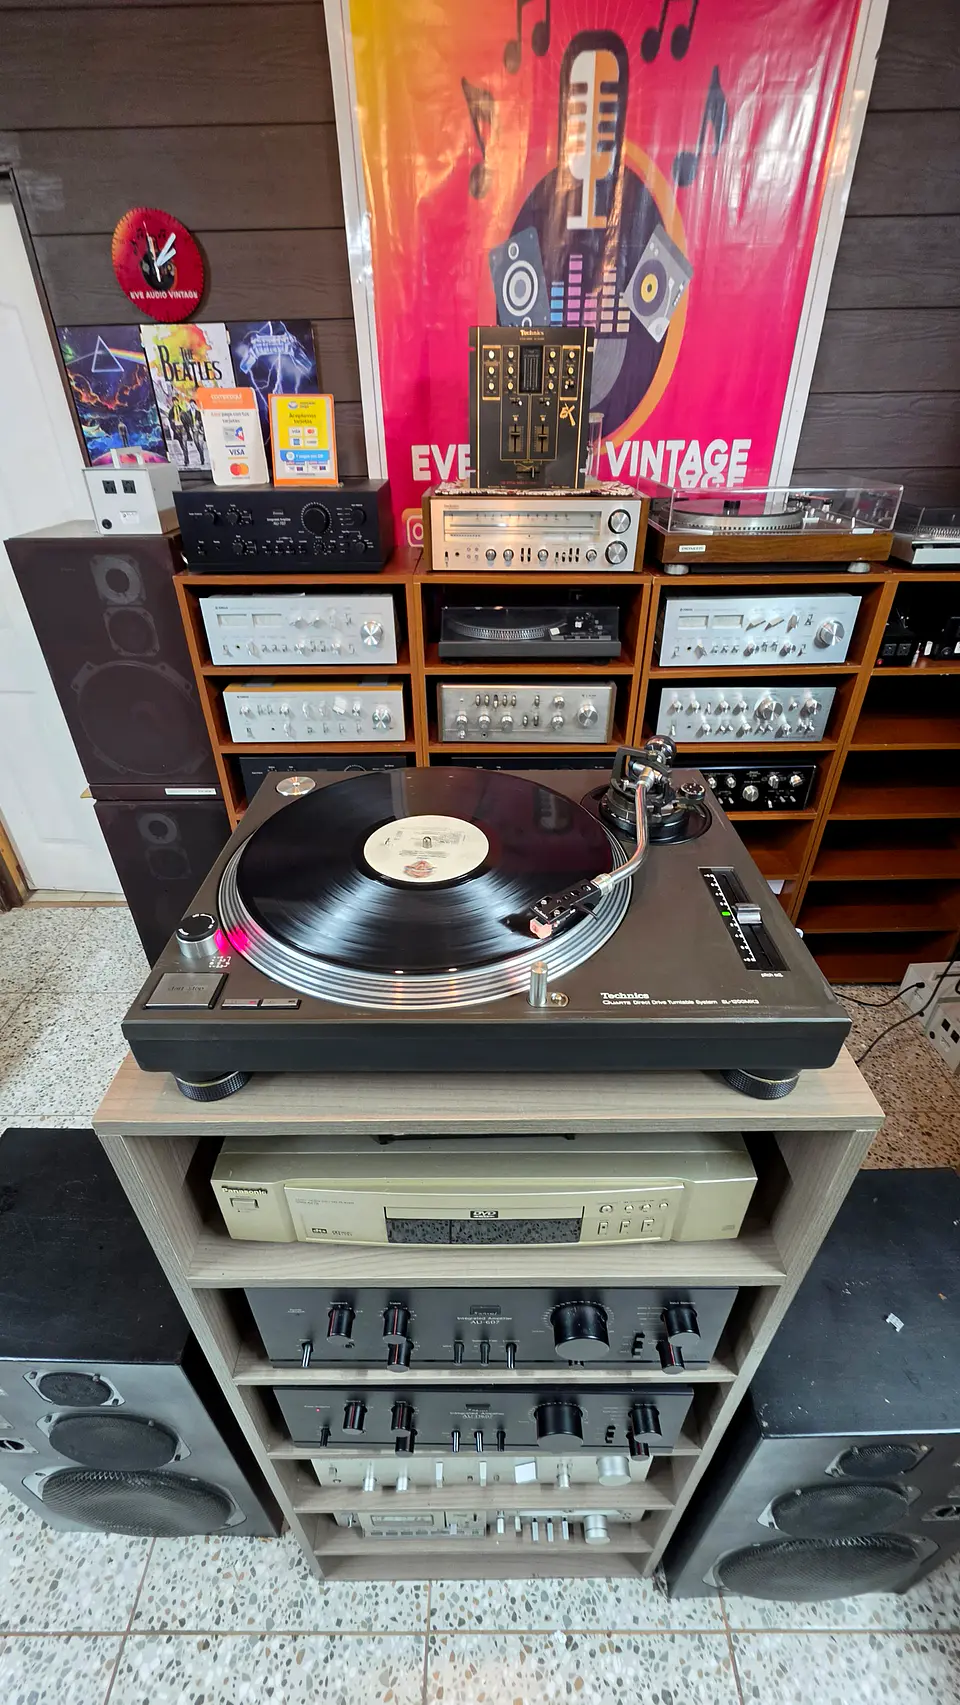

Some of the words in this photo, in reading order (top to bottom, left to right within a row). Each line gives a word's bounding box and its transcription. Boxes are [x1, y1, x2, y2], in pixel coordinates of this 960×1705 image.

[145, 290, 167, 299] AUDIO
[167, 290, 198, 299] VINTAGE
[157, 344, 222, 387] BEATLES
[605, 439, 752, 478] VINTAGE
[600, 992, 650, 1000] Technics
[222, 1186, 268, 1195] Panasonic
